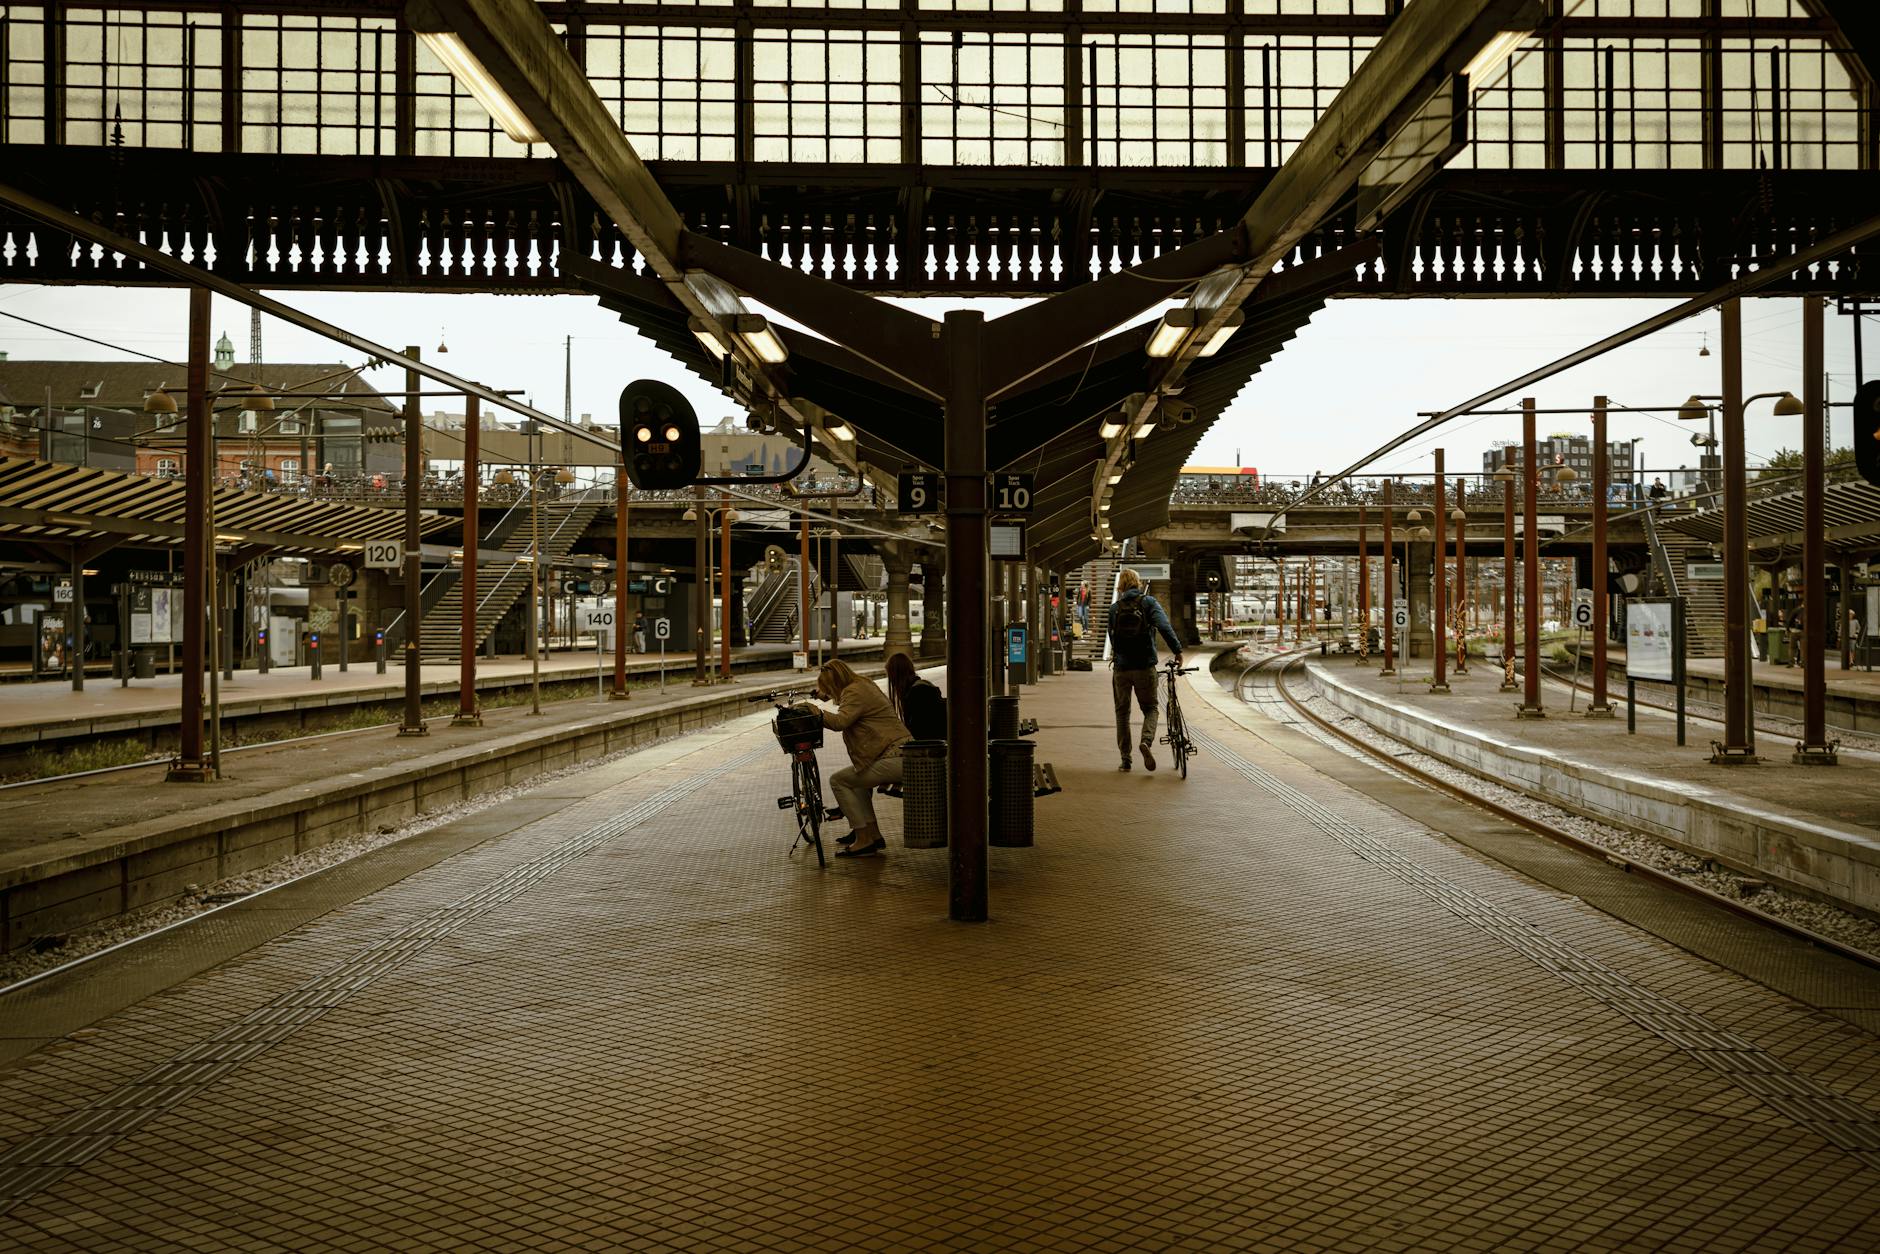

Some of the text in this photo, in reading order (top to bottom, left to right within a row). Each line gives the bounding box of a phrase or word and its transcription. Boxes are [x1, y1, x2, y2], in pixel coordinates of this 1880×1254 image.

[910, 487, 926, 509] 9
[999, 487, 1030, 509] 10
[367, 545, 397, 562] 120
[563, 580, 575, 594] C
[655, 580, 666, 593] C
[587, 613, 613, 625] 140
[1396, 611, 1406, 625] 6
[1577, 604, 1591, 623] 6
[657, 621, 668, 637] 6
